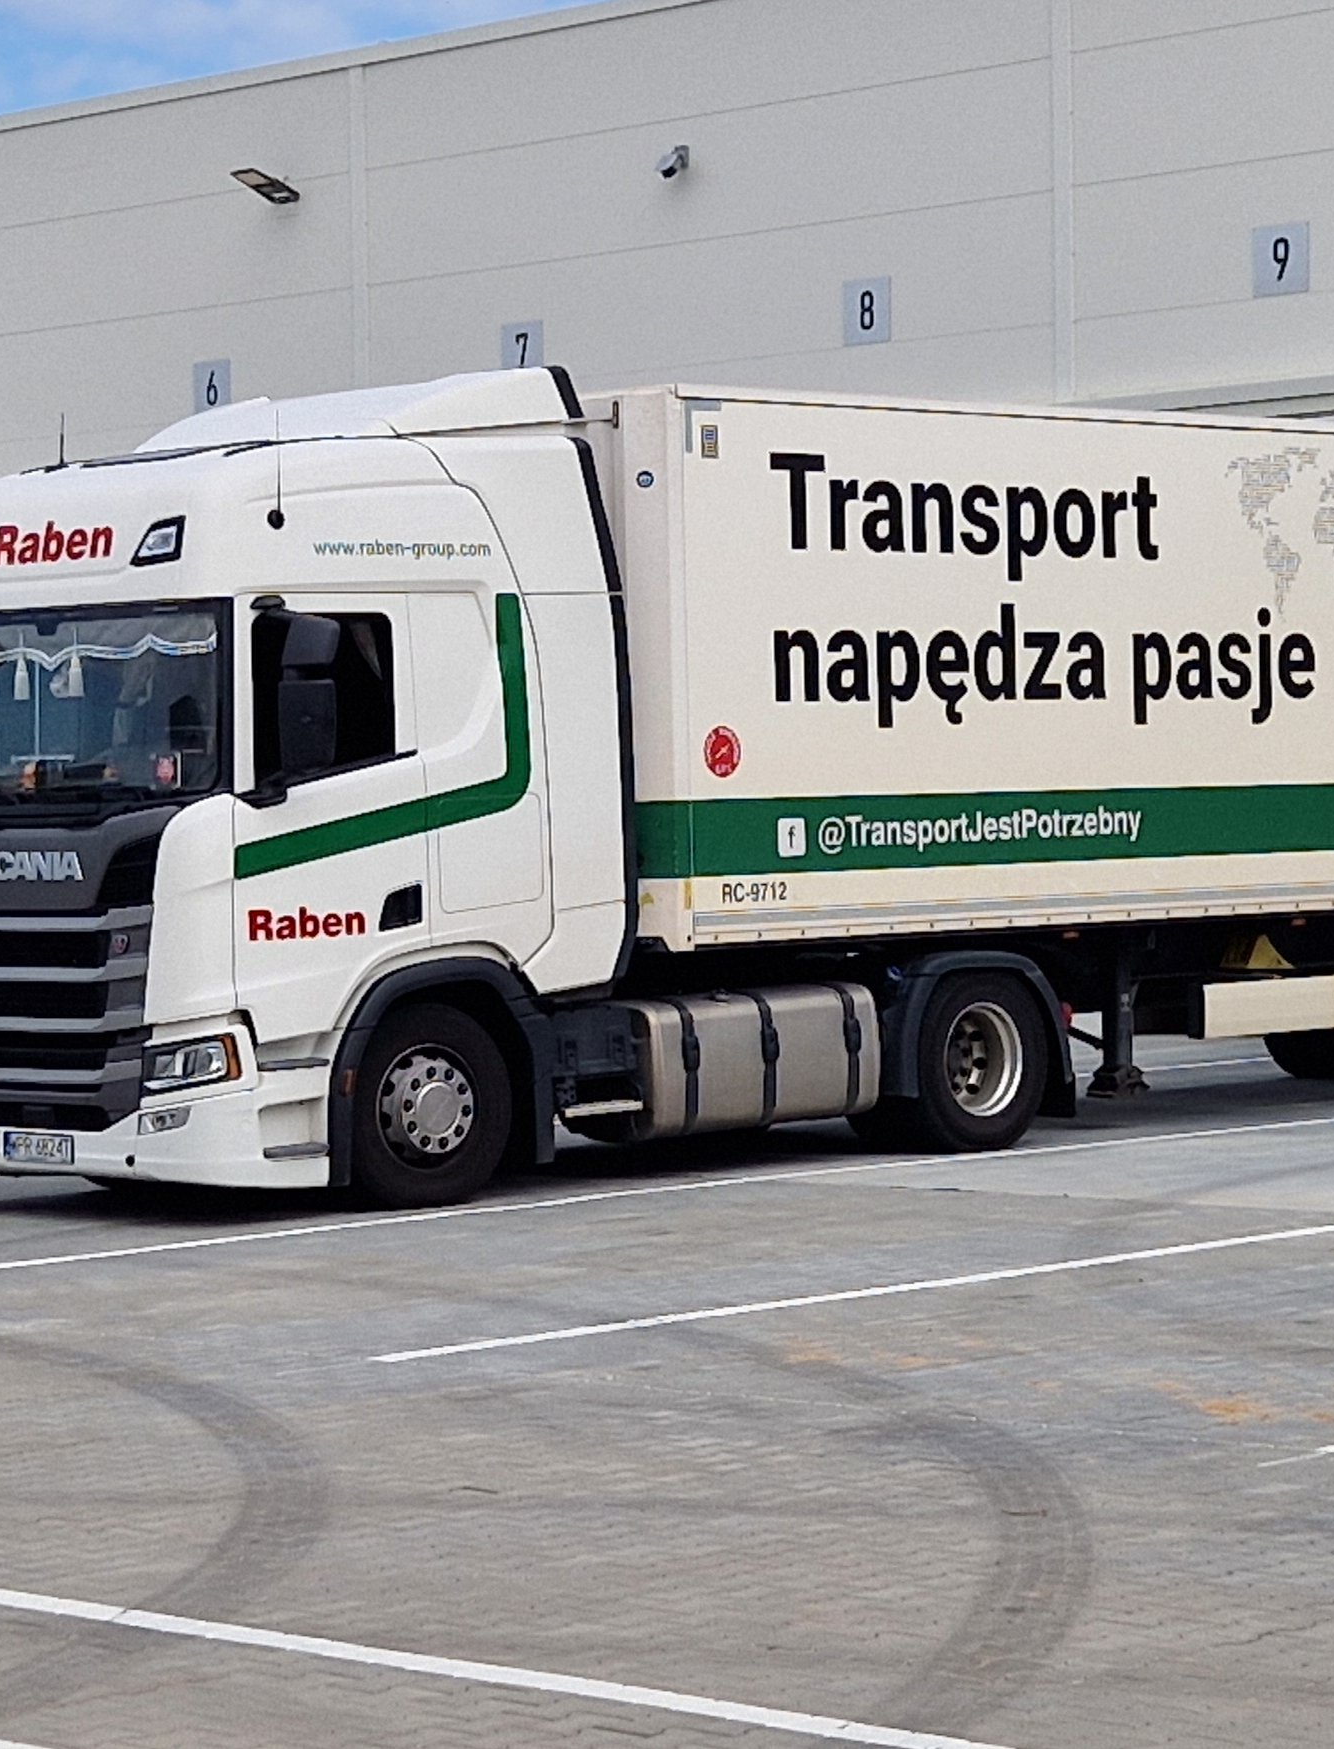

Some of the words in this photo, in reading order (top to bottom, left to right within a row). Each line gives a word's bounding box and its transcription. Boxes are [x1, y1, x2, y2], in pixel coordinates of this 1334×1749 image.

[1272, 236, 1290, 283] 9
[859, 289, 875, 331] 8
[514, 332, 529, 368] 7
[206, 369, 219, 406] 6
[768, 452, 1160, 582] Transport
[313, 539, 491, 560] www.raben-group.com
[772, 603, 1107, 728] napędza
[1132, 607, 1316, 725] pasje
[817, 806, 1142, 853] @TransportJestPotrzebny
[721, 881, 788, 904] RC-9712
[247, 906, 366, 941] Raben
